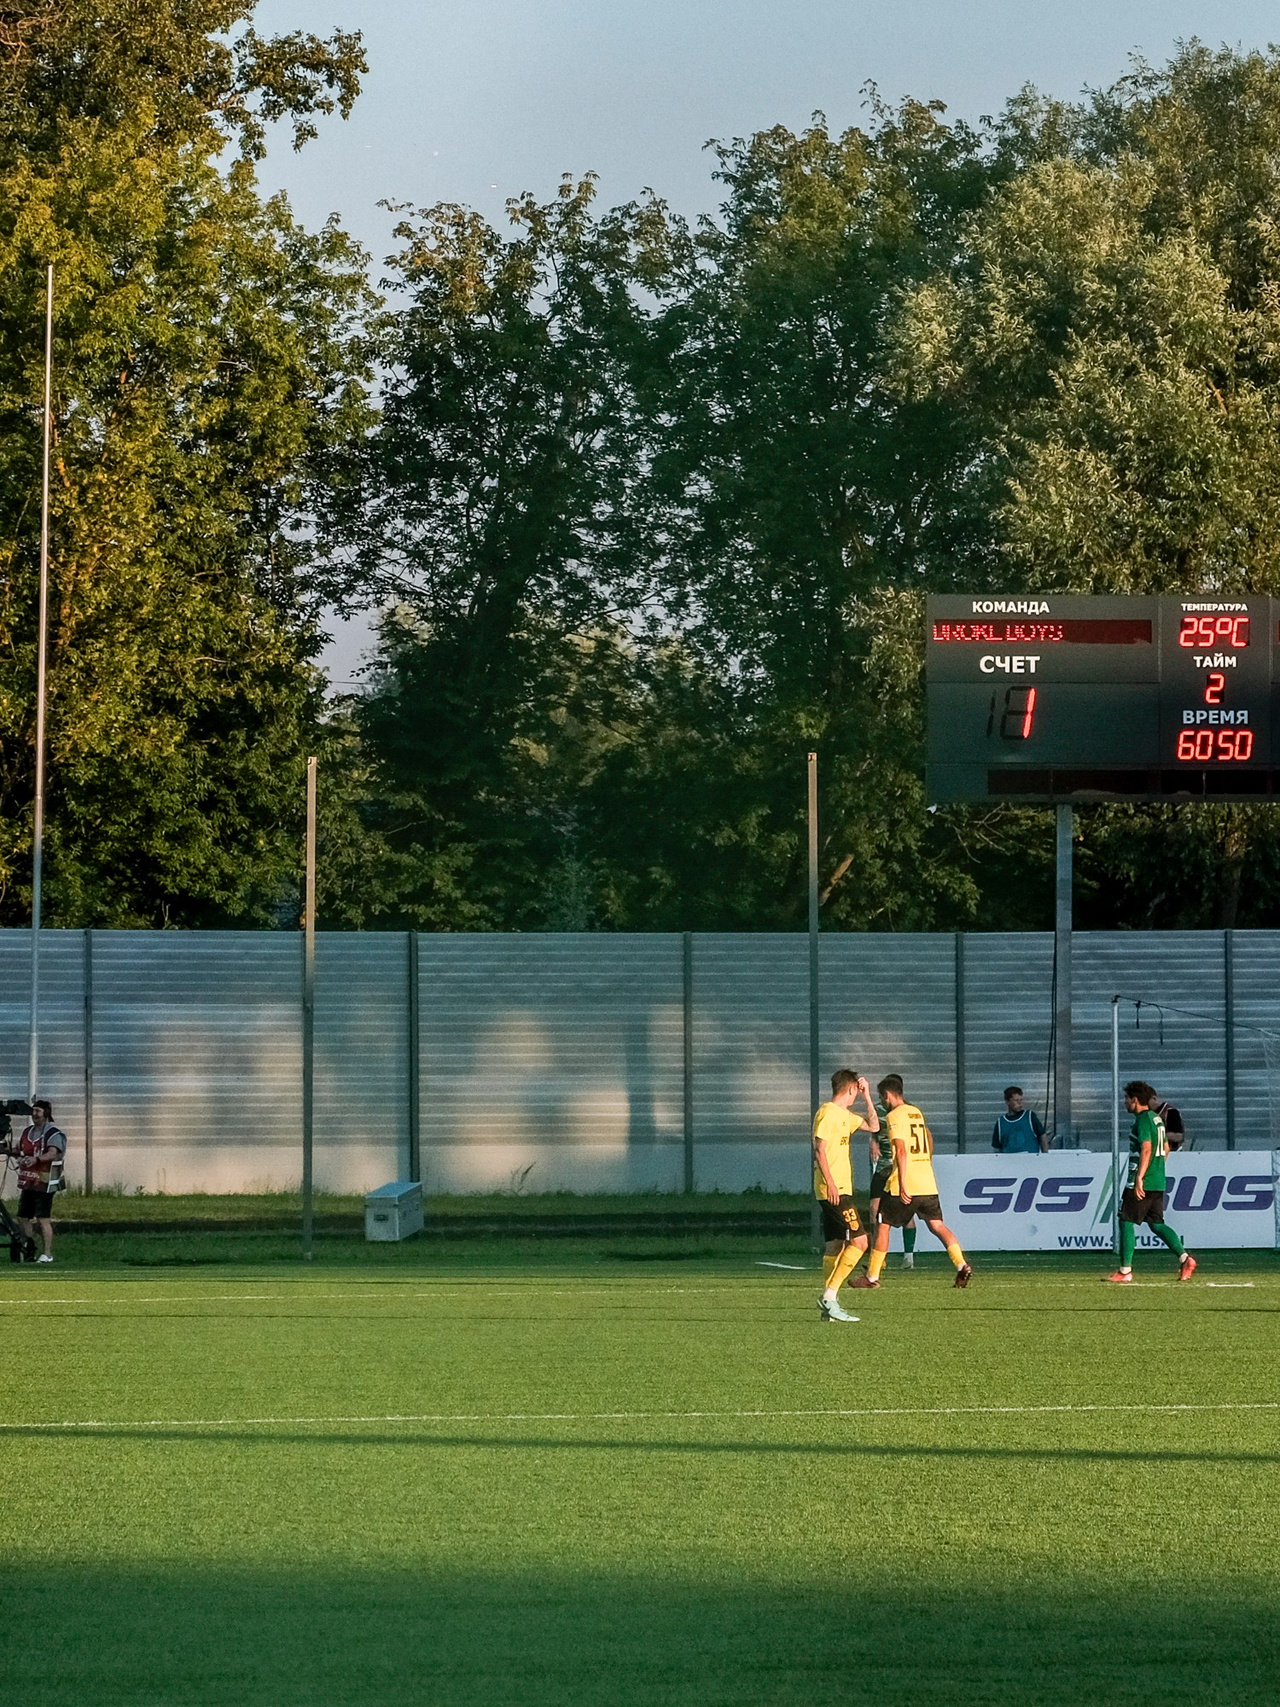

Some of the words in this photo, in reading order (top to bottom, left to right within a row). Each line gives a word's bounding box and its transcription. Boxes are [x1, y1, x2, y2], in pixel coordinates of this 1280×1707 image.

[972, 601, 1050, 615] КОМАНДА
[1181, 603, 1248, 611] ТЕМПЕРАТУРА
[979, 655, 1041, 673] СЧЕТ
[1193, 653, 1237, 668] ТАЙМ
[1205, 674, 1225, 704] 2
[1022, 687, 1037, 739] 1
[1182, 710, 1249, 724] ВРЕМЯ
[959, 1176, 1094, 1213] SIS
[843, 1208, 856, 1222] 33
